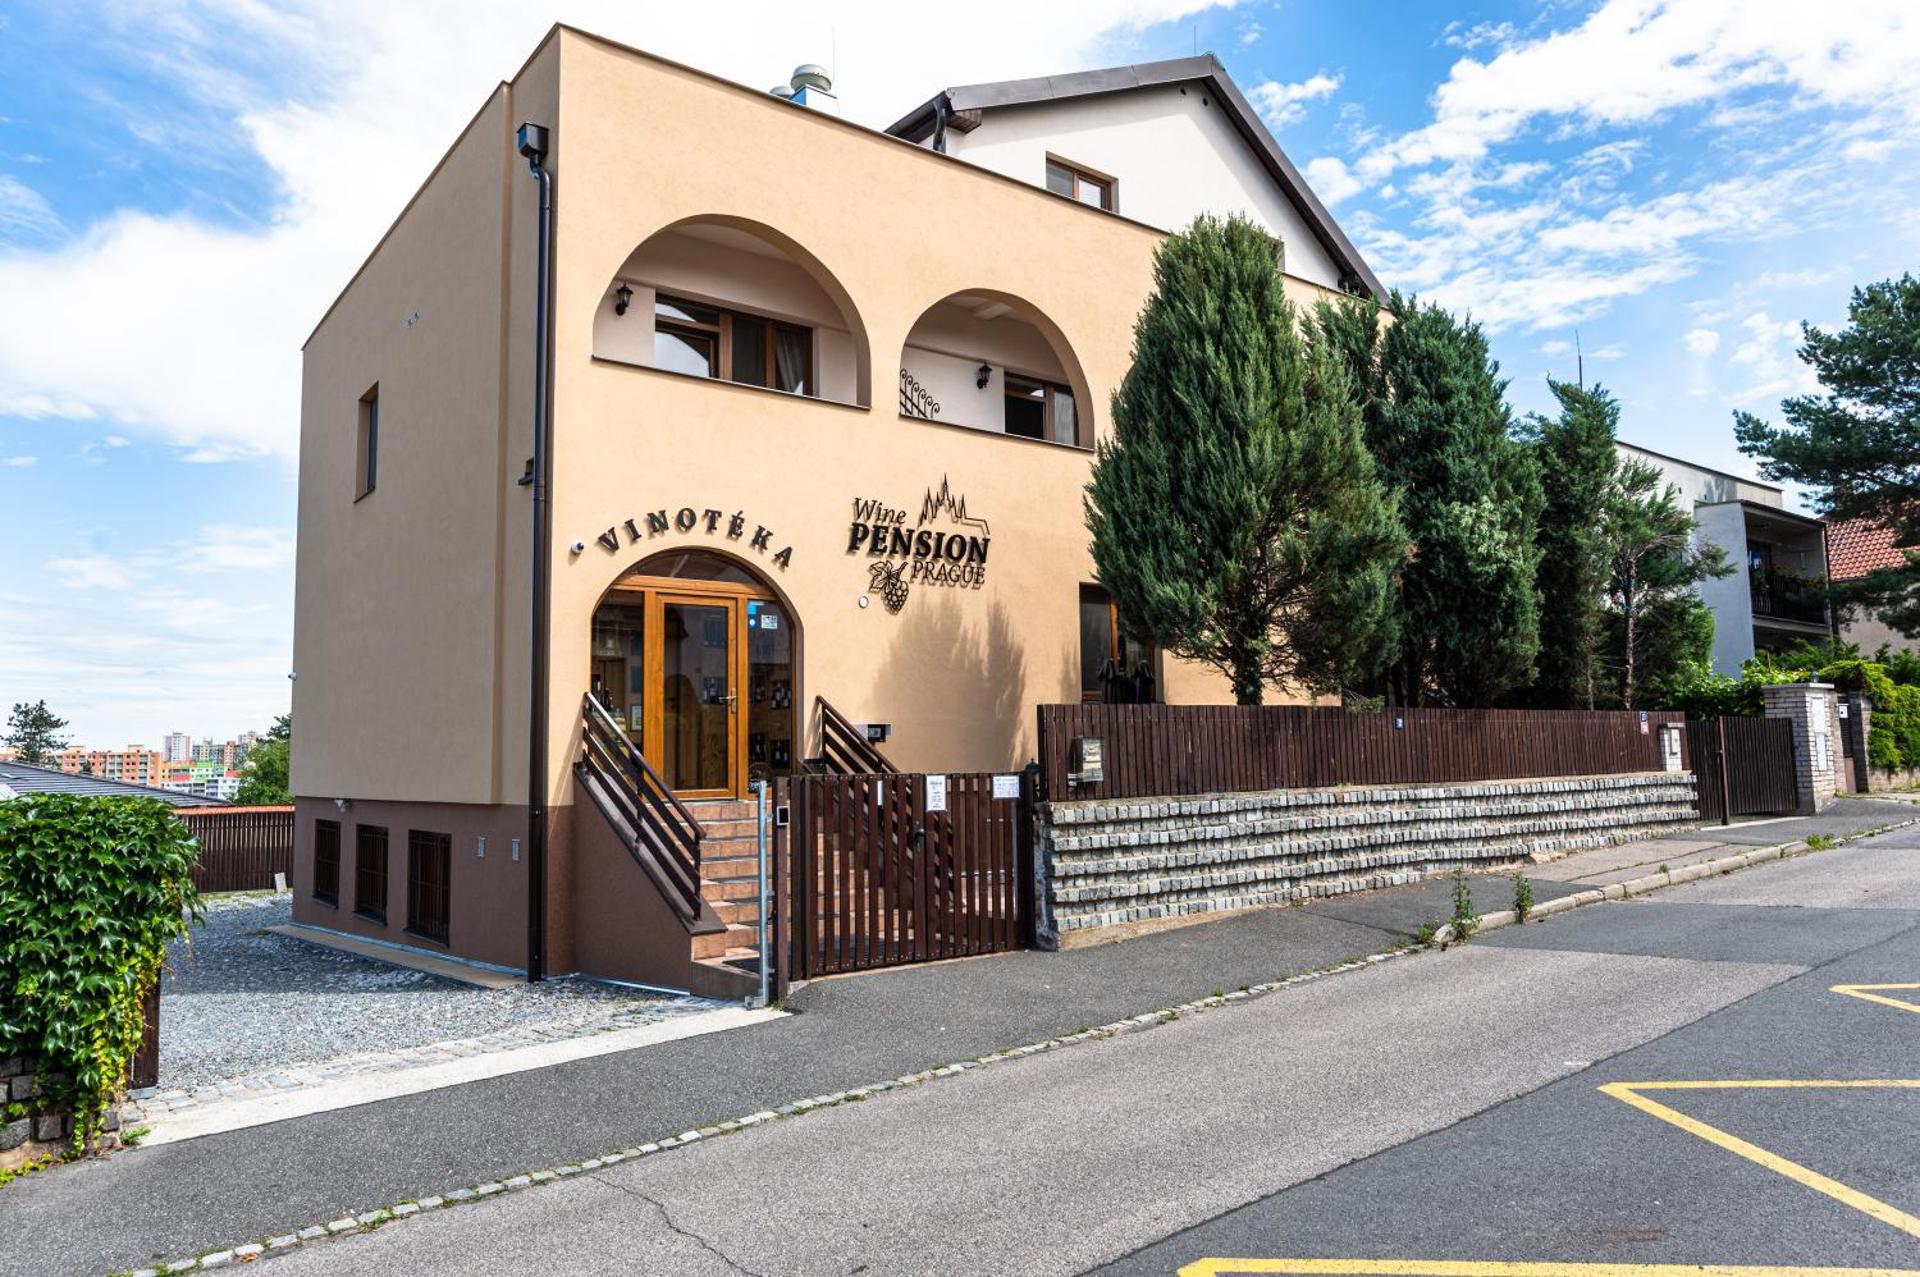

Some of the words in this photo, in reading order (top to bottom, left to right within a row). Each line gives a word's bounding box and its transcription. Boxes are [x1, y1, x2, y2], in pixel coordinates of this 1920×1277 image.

[854, 497, 907, 524] Wine
[597, 507, 793, 568] VINOTÉKA
[847, 522, 991, 563] PENSION
[911, 560, 985, 585] PRAGUE
